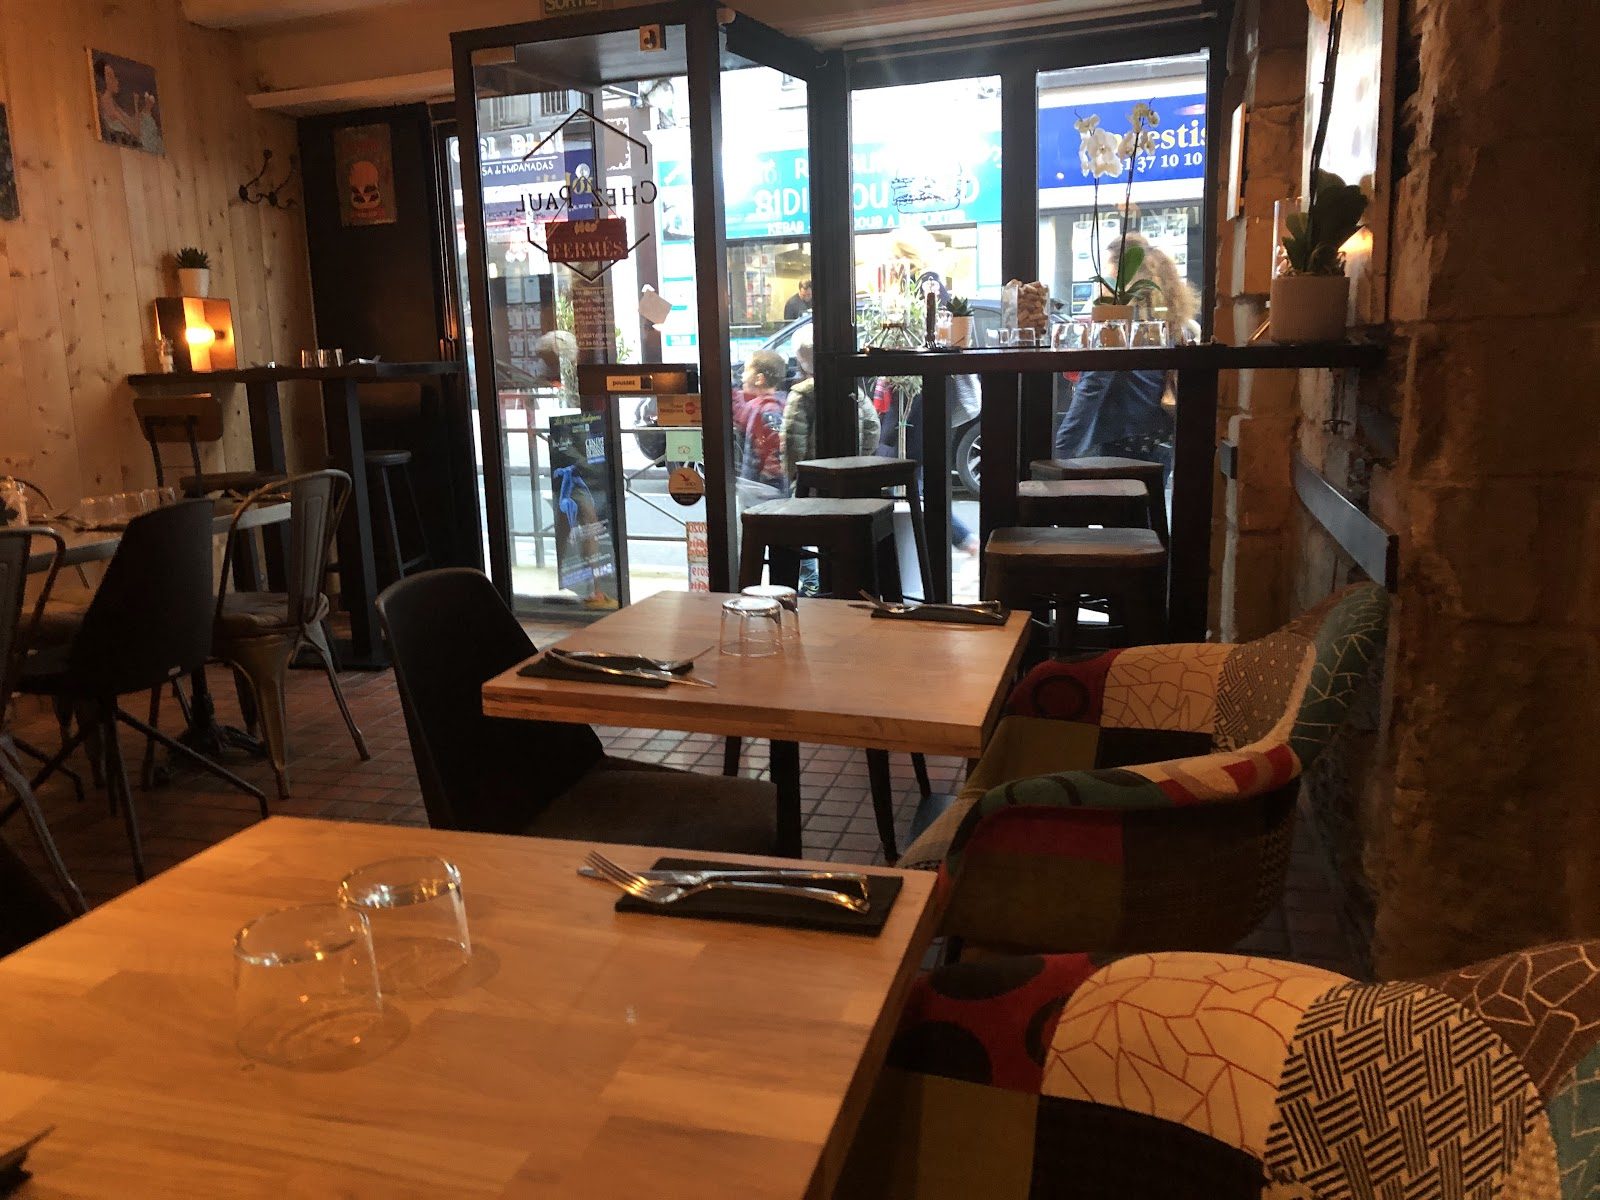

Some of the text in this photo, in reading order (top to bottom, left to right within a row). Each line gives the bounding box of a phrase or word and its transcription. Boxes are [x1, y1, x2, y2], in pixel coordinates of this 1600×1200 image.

[502, 160, 554, 174] EMPANADAS
[1160, 154, 1180, 168] 10
[1183, 151, 1203, 166] 10
[552, 236, 624, 260] FERMÉS
